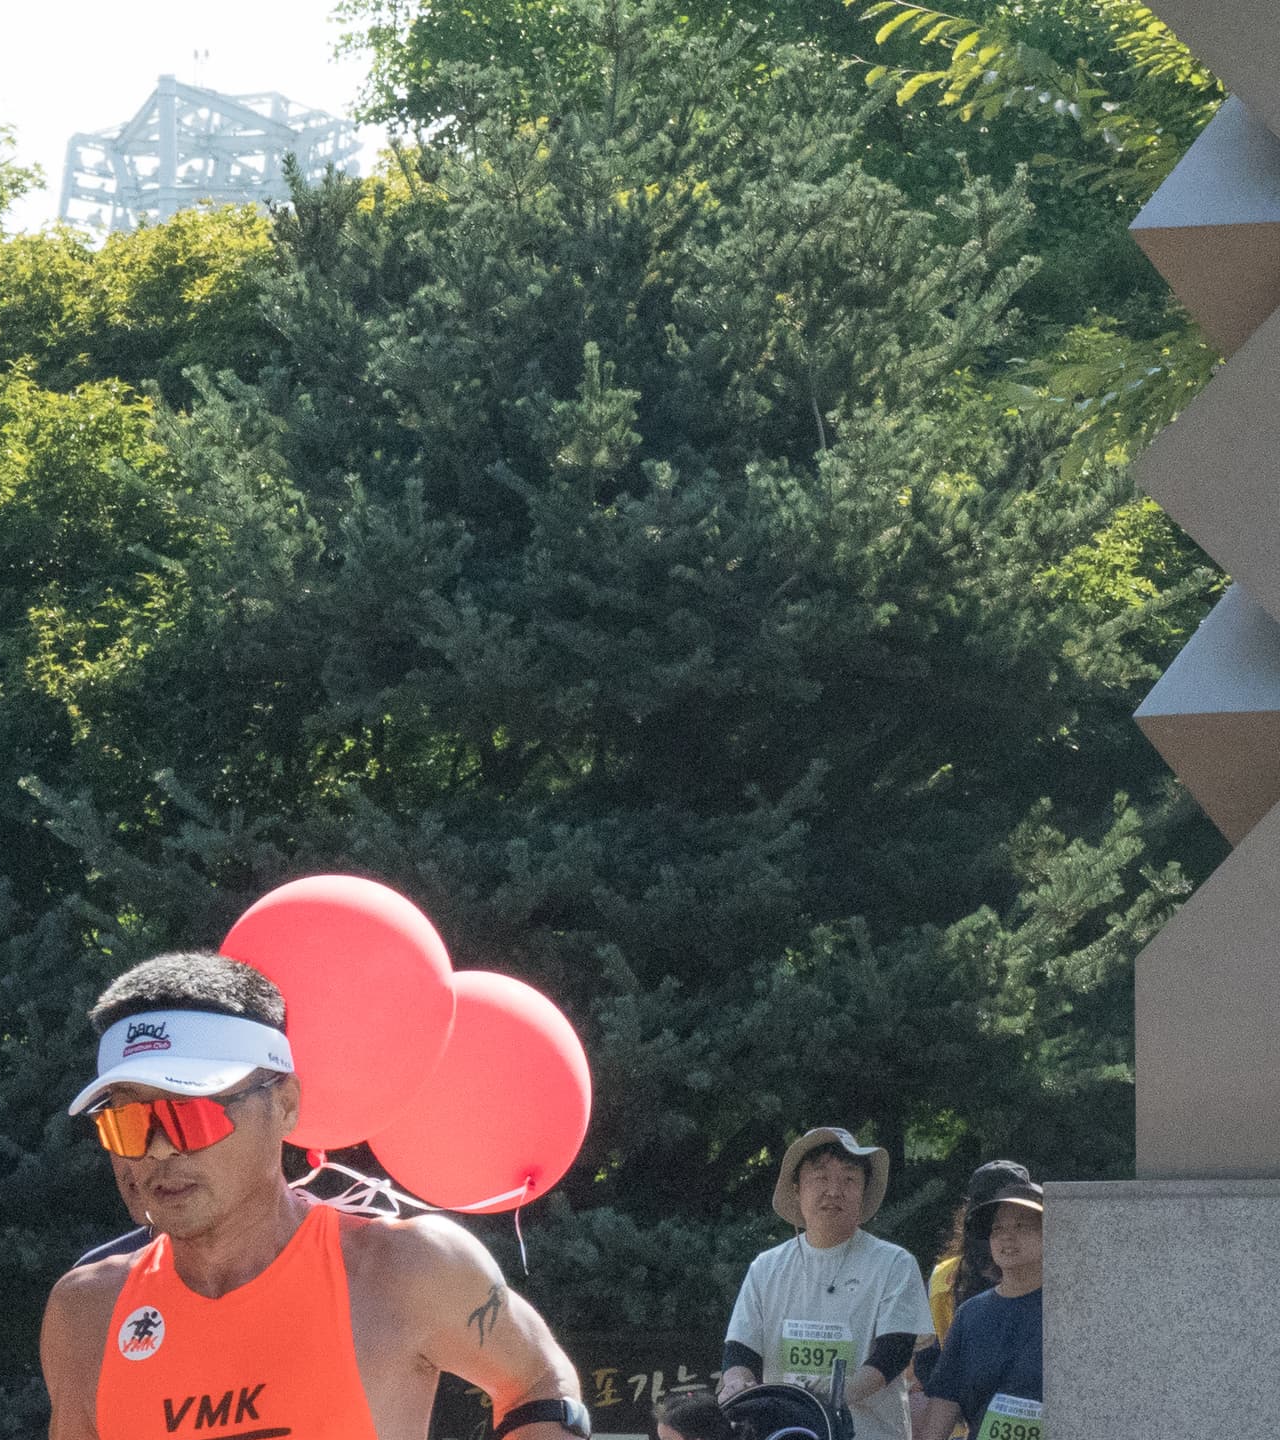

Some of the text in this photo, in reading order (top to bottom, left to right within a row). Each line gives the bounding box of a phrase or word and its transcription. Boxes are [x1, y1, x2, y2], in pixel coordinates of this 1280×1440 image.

[123, 1335, 159, 1353] VMK
[790, 1346, 838, 1368] 6397
[163, 1383, 266, 1433] VMK
